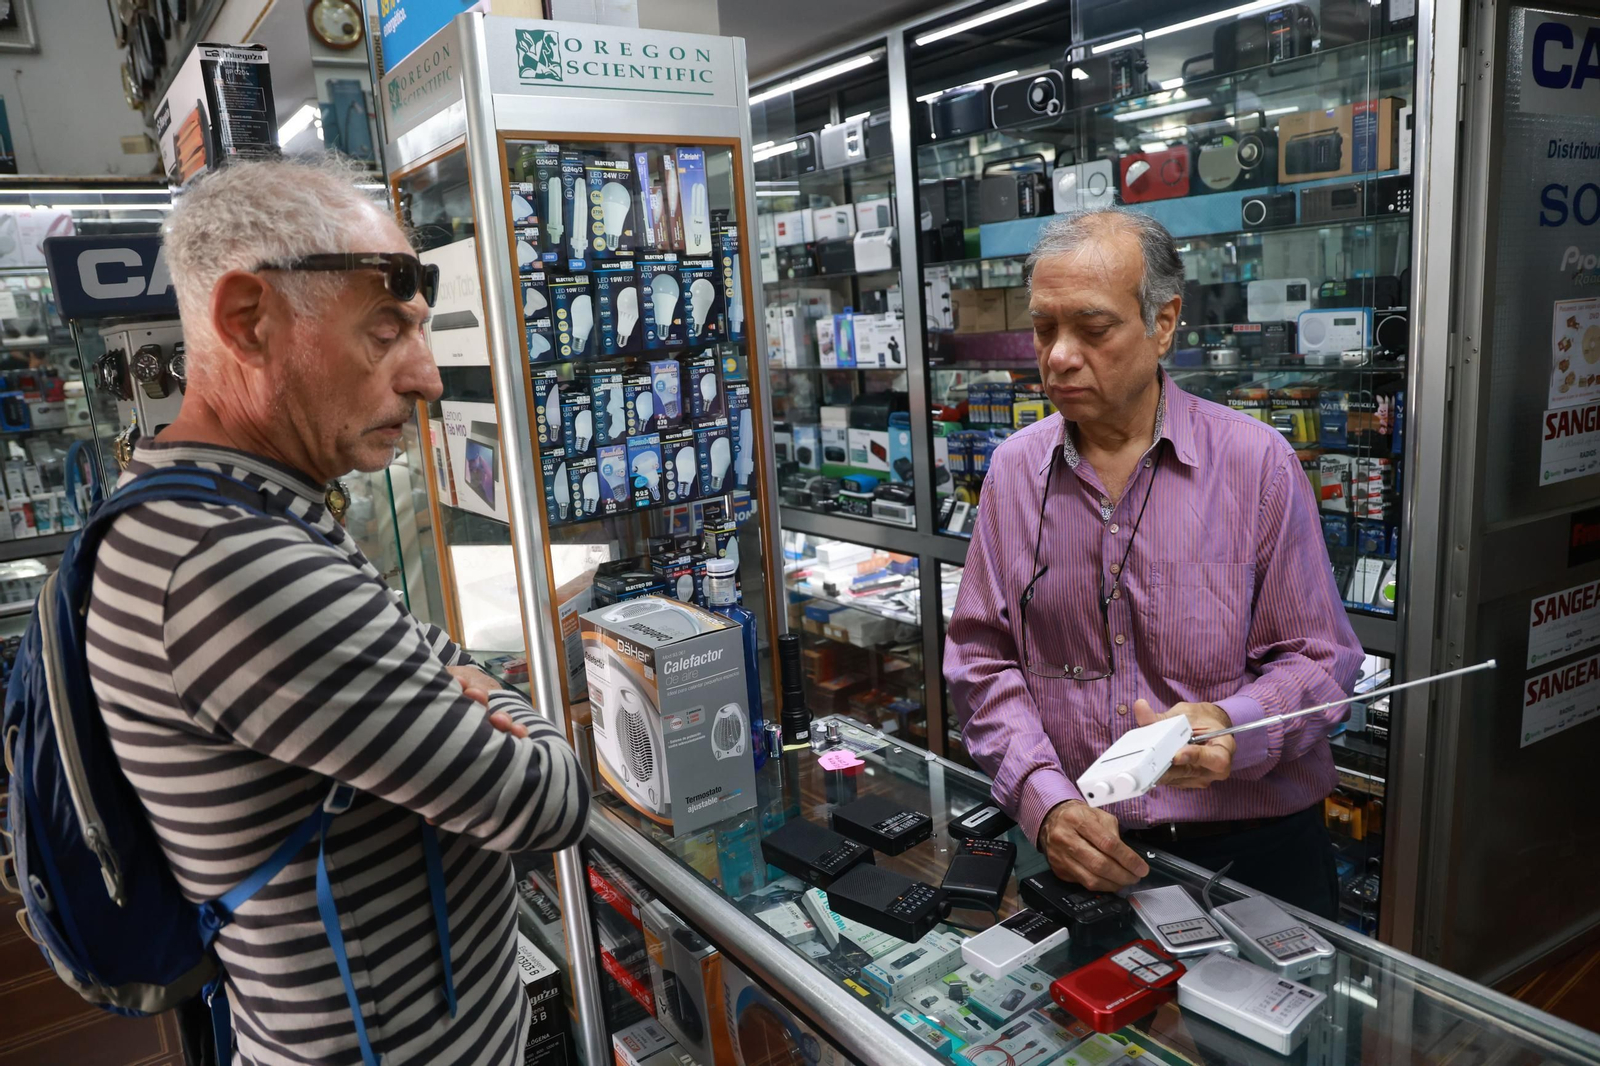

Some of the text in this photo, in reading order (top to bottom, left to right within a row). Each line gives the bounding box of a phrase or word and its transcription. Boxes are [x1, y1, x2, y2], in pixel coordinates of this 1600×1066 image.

[564, 38, 711, 62] OREGON
[401, 43, 451, 91] OREGON
[567, 60, 714, 83] SCIENTIFIC
[402, 66, 453, 106] SCIENTIFIC
[1540, 182, 1600, 227] SO
[1322, 463, 1347, 474] Energizer
[625, 583, 646, 592] ELECTRO
[617, 638, 650, 663] DäHer
[664, 648, 724, 675] Calefactor
[665, 669, 699, 686] de aire
[1526, 657, 1600, 707] SANGEA
[685, 786, 722, 805] Termostato
[687, 796, 718, 814] ajustable
[844, 840, 860, 848] SONY
[525, 1033, 551, 1048] ALÓGENA
